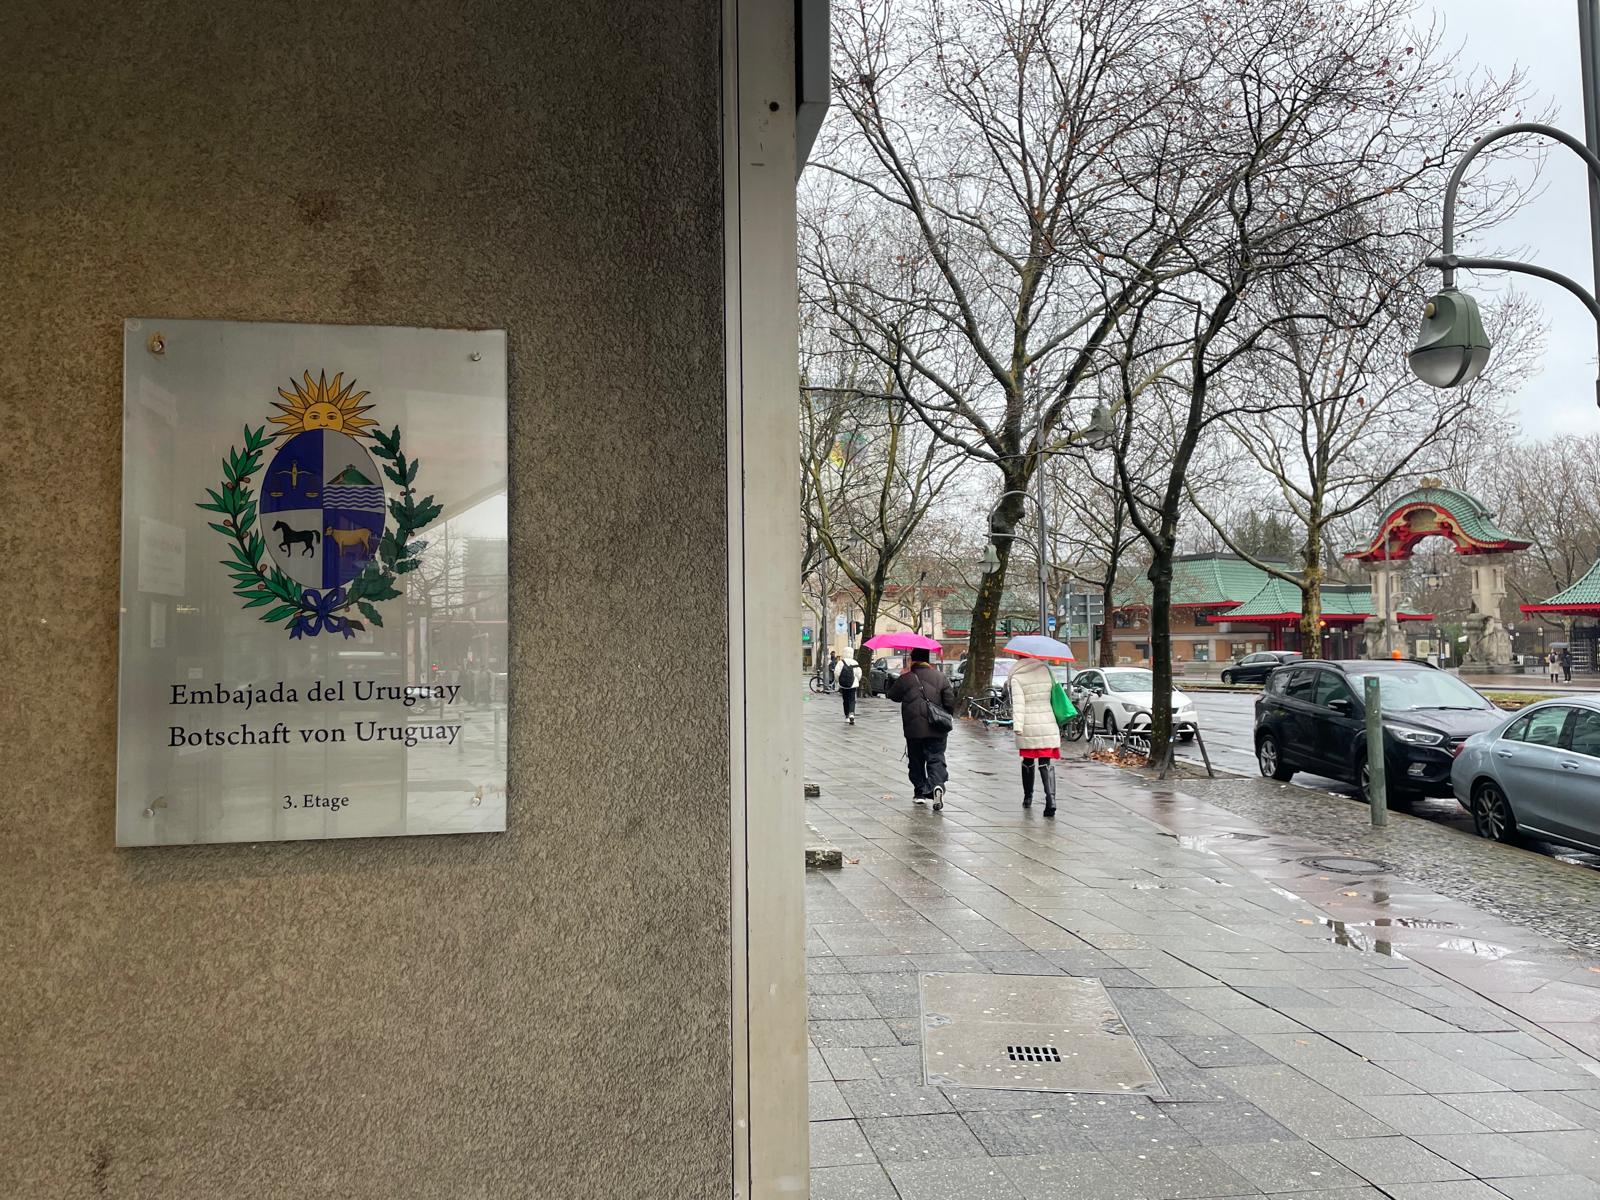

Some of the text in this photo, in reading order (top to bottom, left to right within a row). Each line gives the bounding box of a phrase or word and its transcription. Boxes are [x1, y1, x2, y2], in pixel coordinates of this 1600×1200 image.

[169, 680, 461, 710] Embajada del Uruguay
[168, 721, 461, 748] Botschaft von Uruguay
[282, 793, 350, 812] 3. Etage
